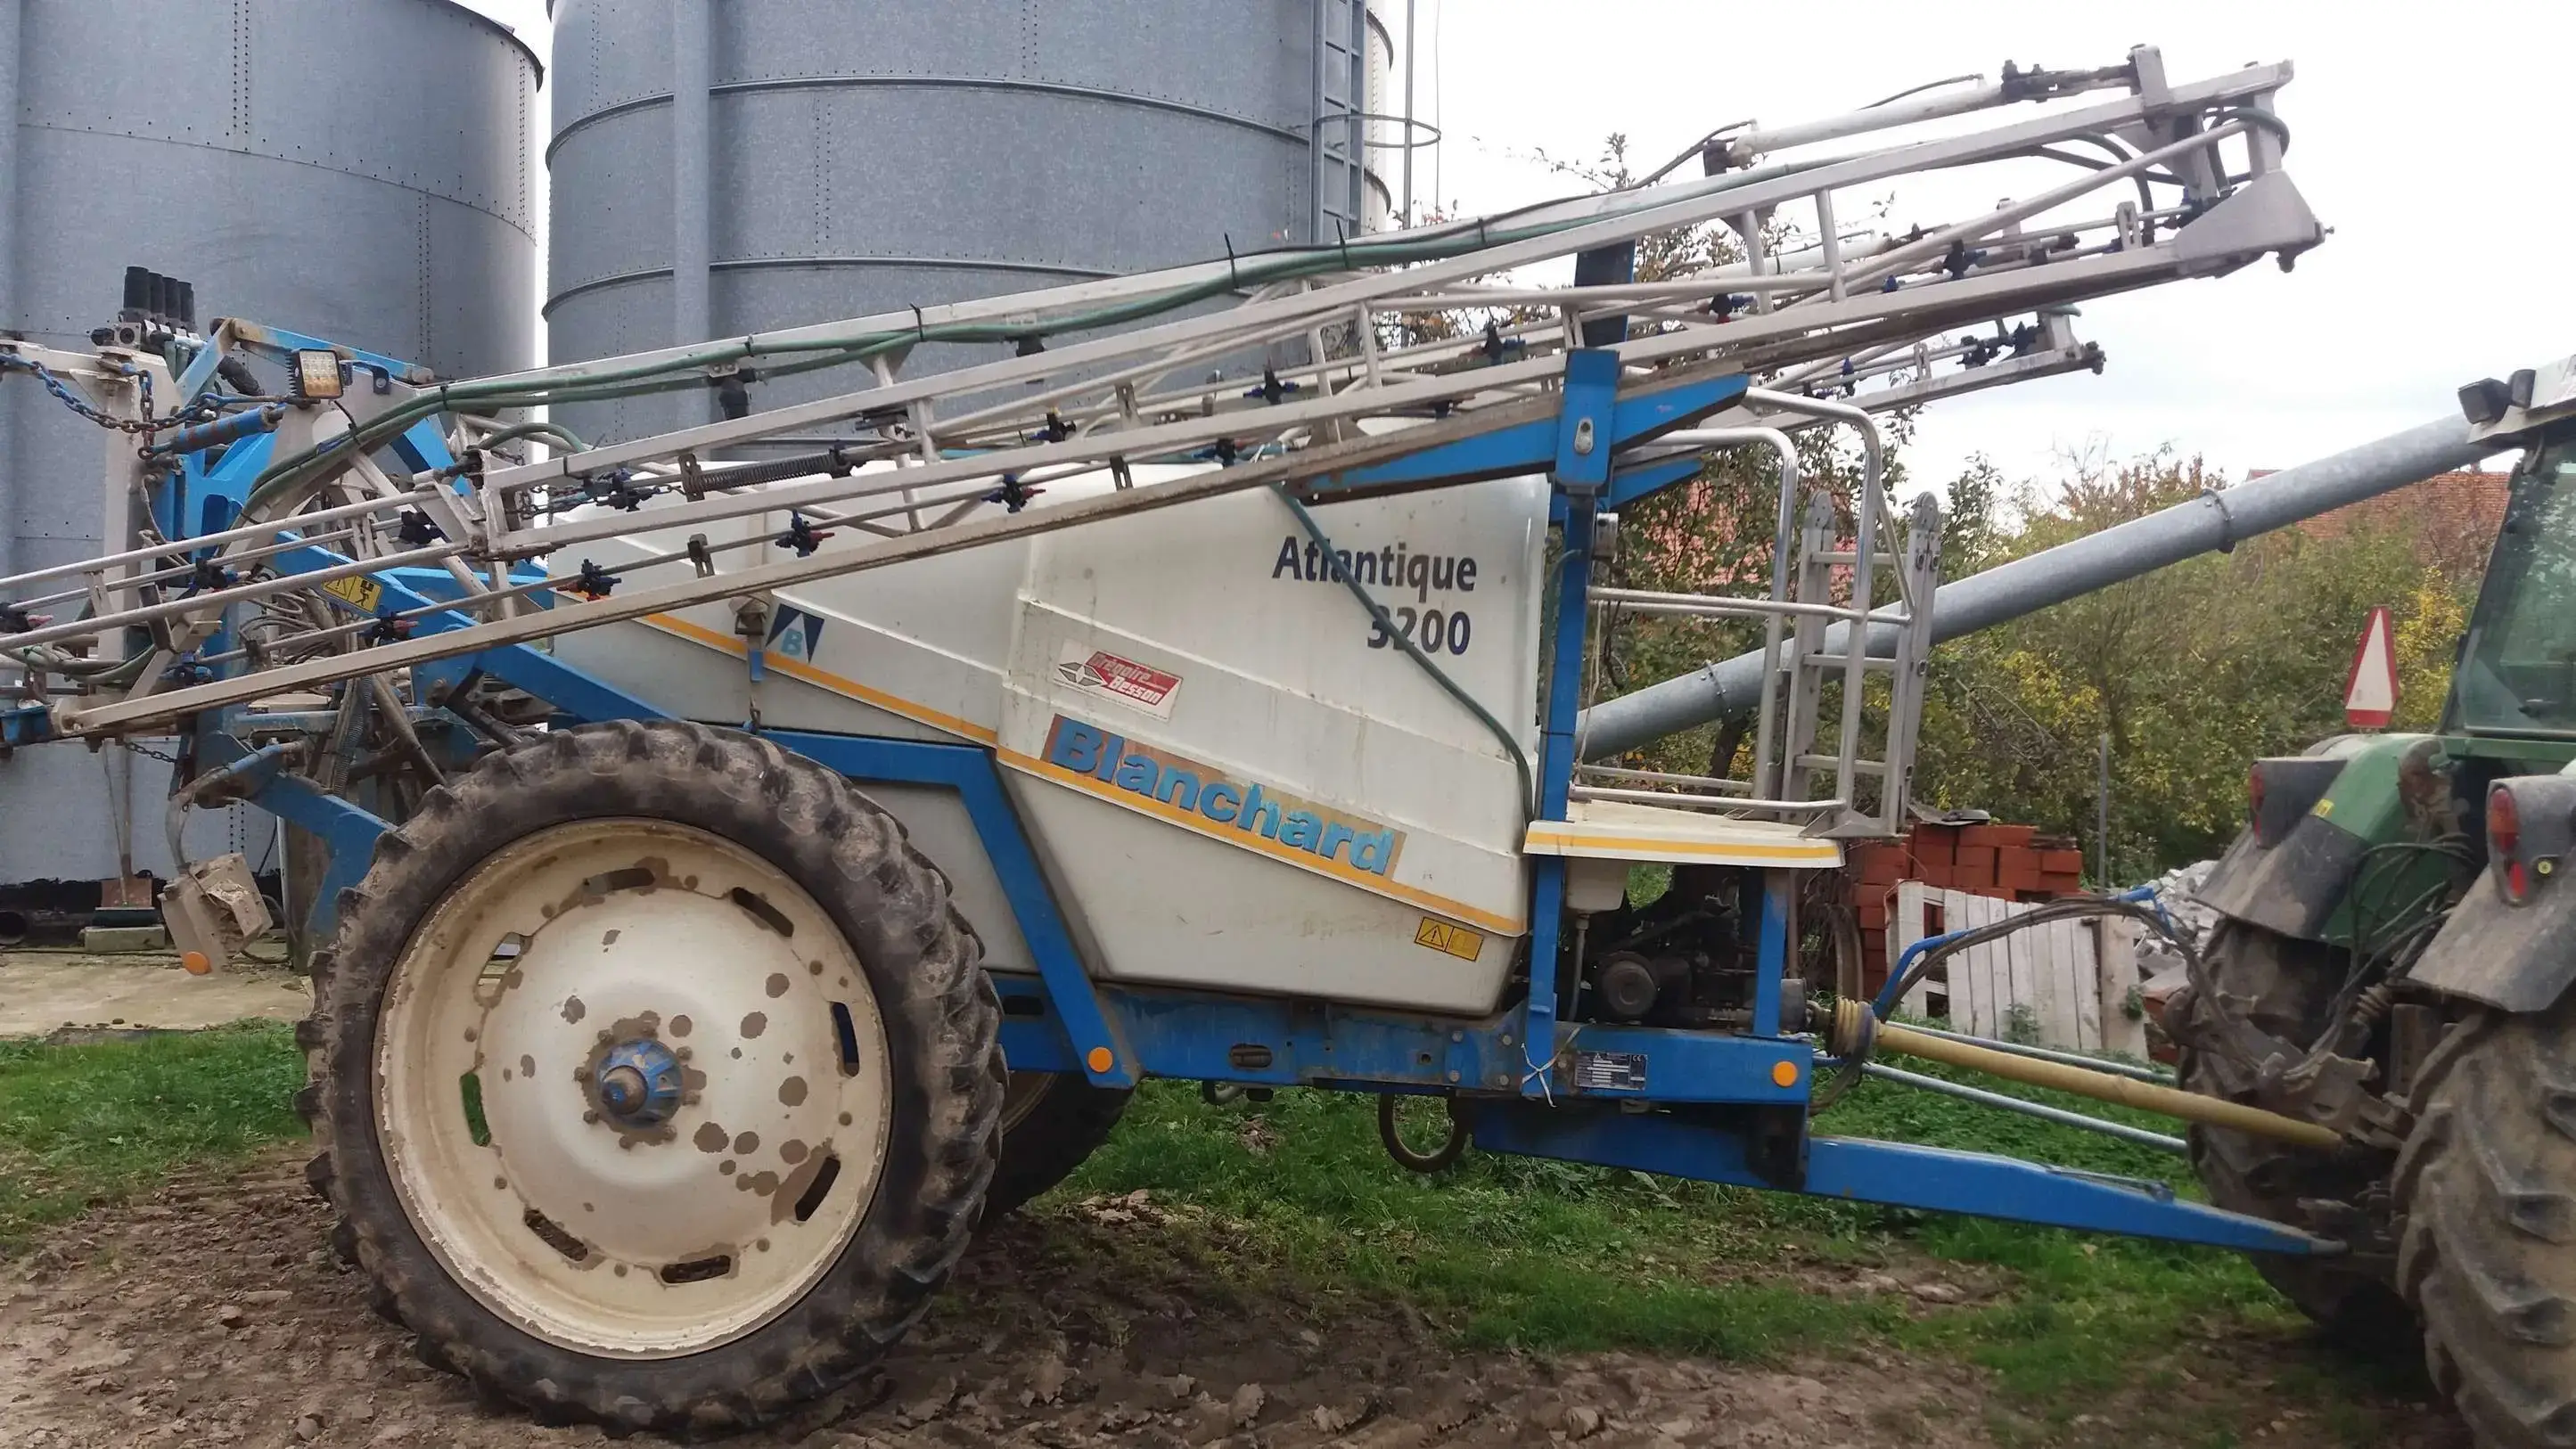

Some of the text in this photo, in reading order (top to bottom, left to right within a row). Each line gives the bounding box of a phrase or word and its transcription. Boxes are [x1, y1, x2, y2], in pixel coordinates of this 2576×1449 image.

[1272, 536, 1477, 603] Atlantique
[1367, 605, 1471, 655] 3200
[1108, 675, 1163, 705] Besson
[1050, 716, 1394, 877] Blanchard
